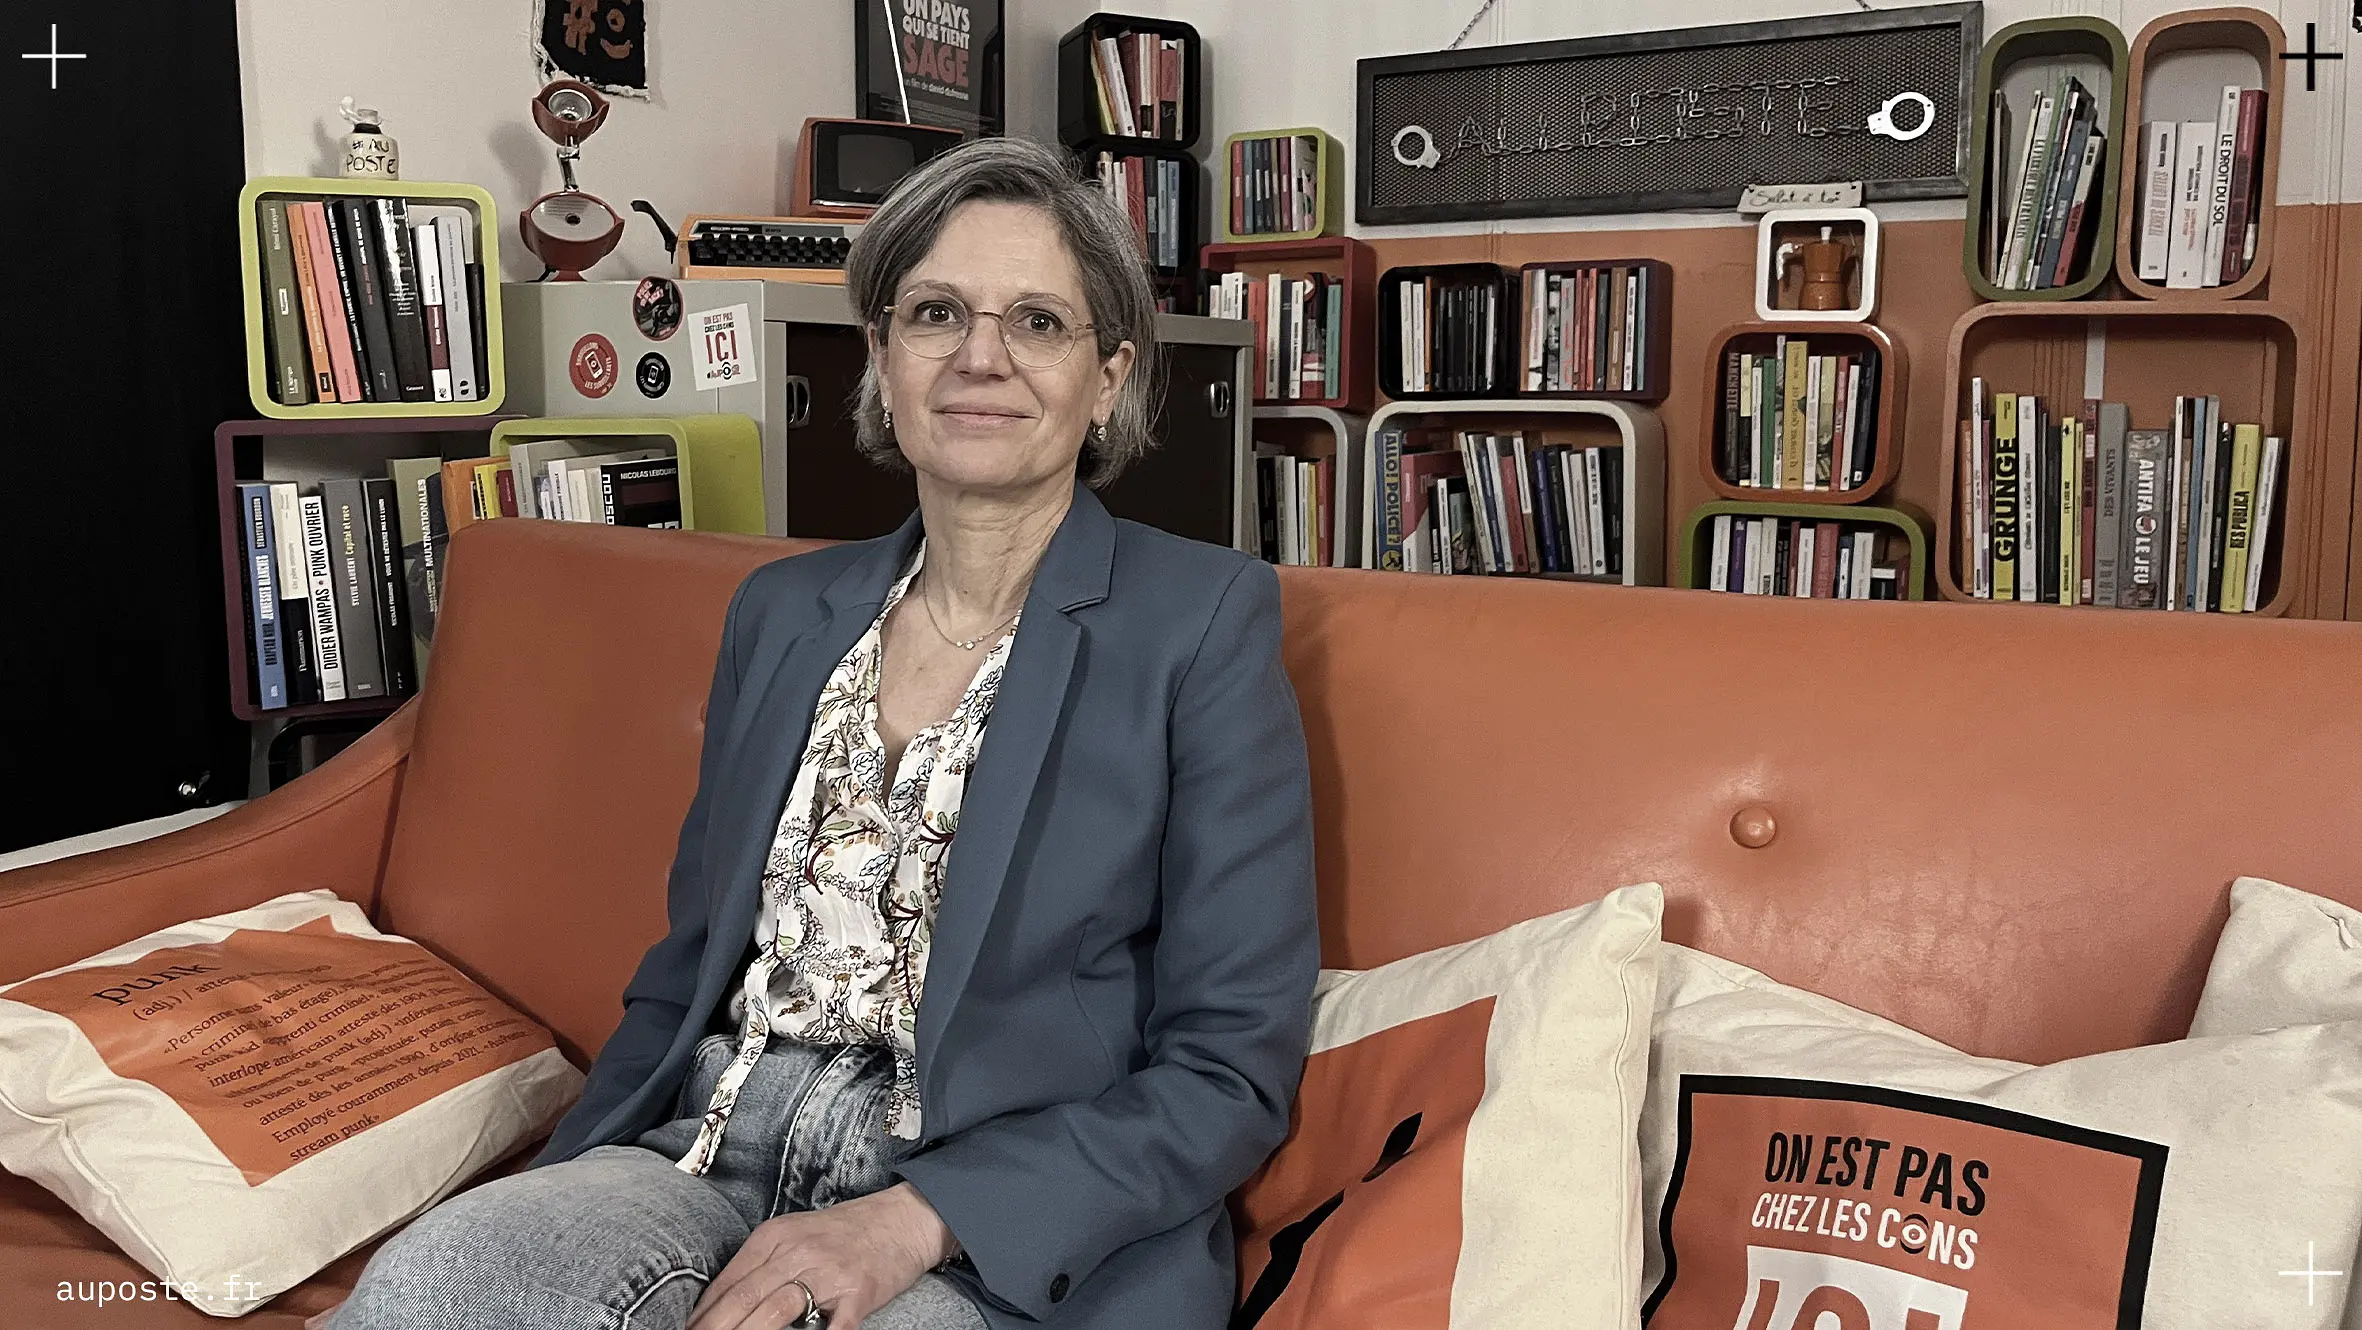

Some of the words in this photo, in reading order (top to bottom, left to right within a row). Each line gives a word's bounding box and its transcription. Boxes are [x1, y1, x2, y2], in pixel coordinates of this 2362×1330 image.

[902, 15, 925, 37] QUI
[926, 22, 939, 41] SE
[940, 27, 970, 50] TIENT
[931, 0, 970, 33] PAYS
[903, 34, 969, 88] SAGE
[2221, 134, 2233, 146] LE
[346, 153, 396, 175] POSTE
[2217, 150, 2231, 184] DROIT
[2215, 186, 2227, 202] DU
[2213, 205, 2225, 228] SOL
[705, 329, 738, 365] ICI
[621, 471, 648, 479] NICOLAS
[2137, 459, 2154, 512] ANTIFA
[599, 473, 614, 525] OSCOU
[1993, 438, 2018, 562] GRUNGE
[305, 502, 324, 551] OUVRIER
[418, 477, 434, 567] MULTINATIONALES
[343, 531, 355, 554] Capital
[2135, 537, 2151, 553] LE
[310, 549, 327, 576] PUNK
[347, 558, 357, 584] LAURENT
[2134, 557, 2149, 583] JEU
[315, 589, 334, 634] WAMPAS
[350, 586, 359, 606] SYLVIE
[321, 636, 338, 669] DIDIER
[92, 963, 224, 1007] punk
[132, 995, 183, 1021] (adj.)
[273, 1007, 298, 1025] bas
[208, 1059, 273, 1088] interlope
[272, 1032, 337, 1067] américain
[321, 1042, 359, 1063] punk
[258, 1098, 308, 1126] attesté
[308, 1089, 333, 1104] dès
[330, 1080, 353, 1093] les
[271, 1107, 337, 1144] Employé
[336, 1072, 419, 1114] couramment
[289, 1129, 341, 1161] stream
[1764, 1131, 1814, 1184] ON
[1814, 1136, 1891, 1190] EST
[1893, 1145, 1990, 1217] PAS
[1750, 1192, 1818, 1233] CHEZ
[1816, 1197, 1872, 1242] LES
[1876, 1207, 1979, 1270] CONS
